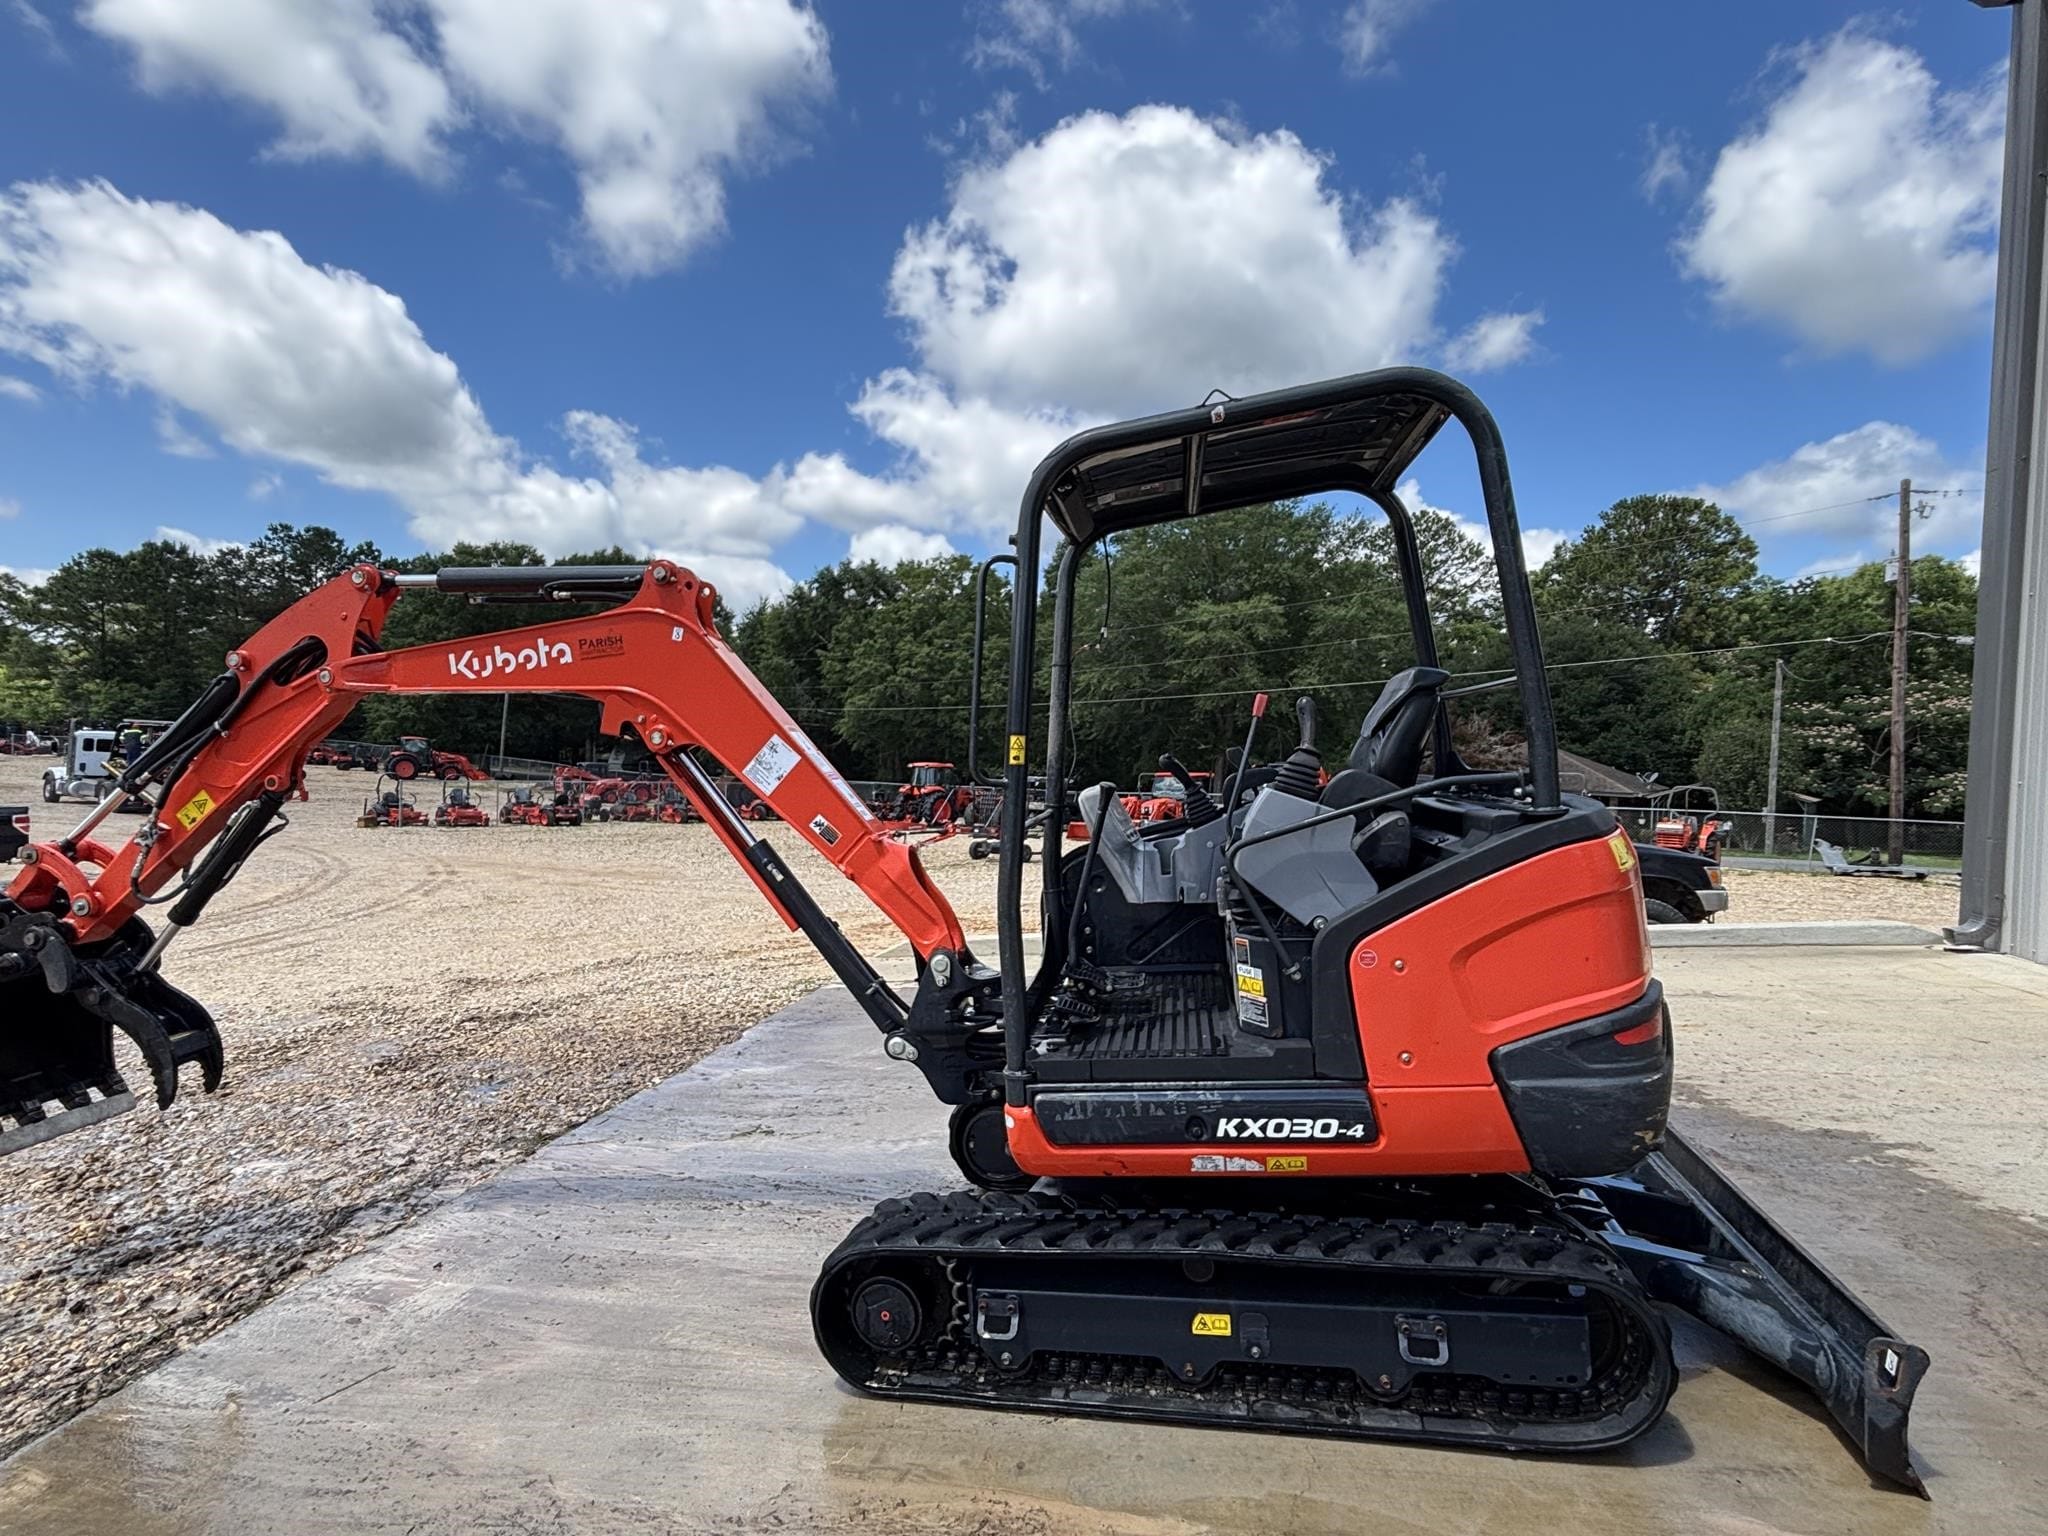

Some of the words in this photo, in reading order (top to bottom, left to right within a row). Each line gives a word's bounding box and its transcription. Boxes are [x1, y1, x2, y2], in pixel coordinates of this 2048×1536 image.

[578, 635, 623, 649] PARISH
[448, 638, 573, 679] Kubota
[1216, 1118, 1365, 1138] KX030-4
